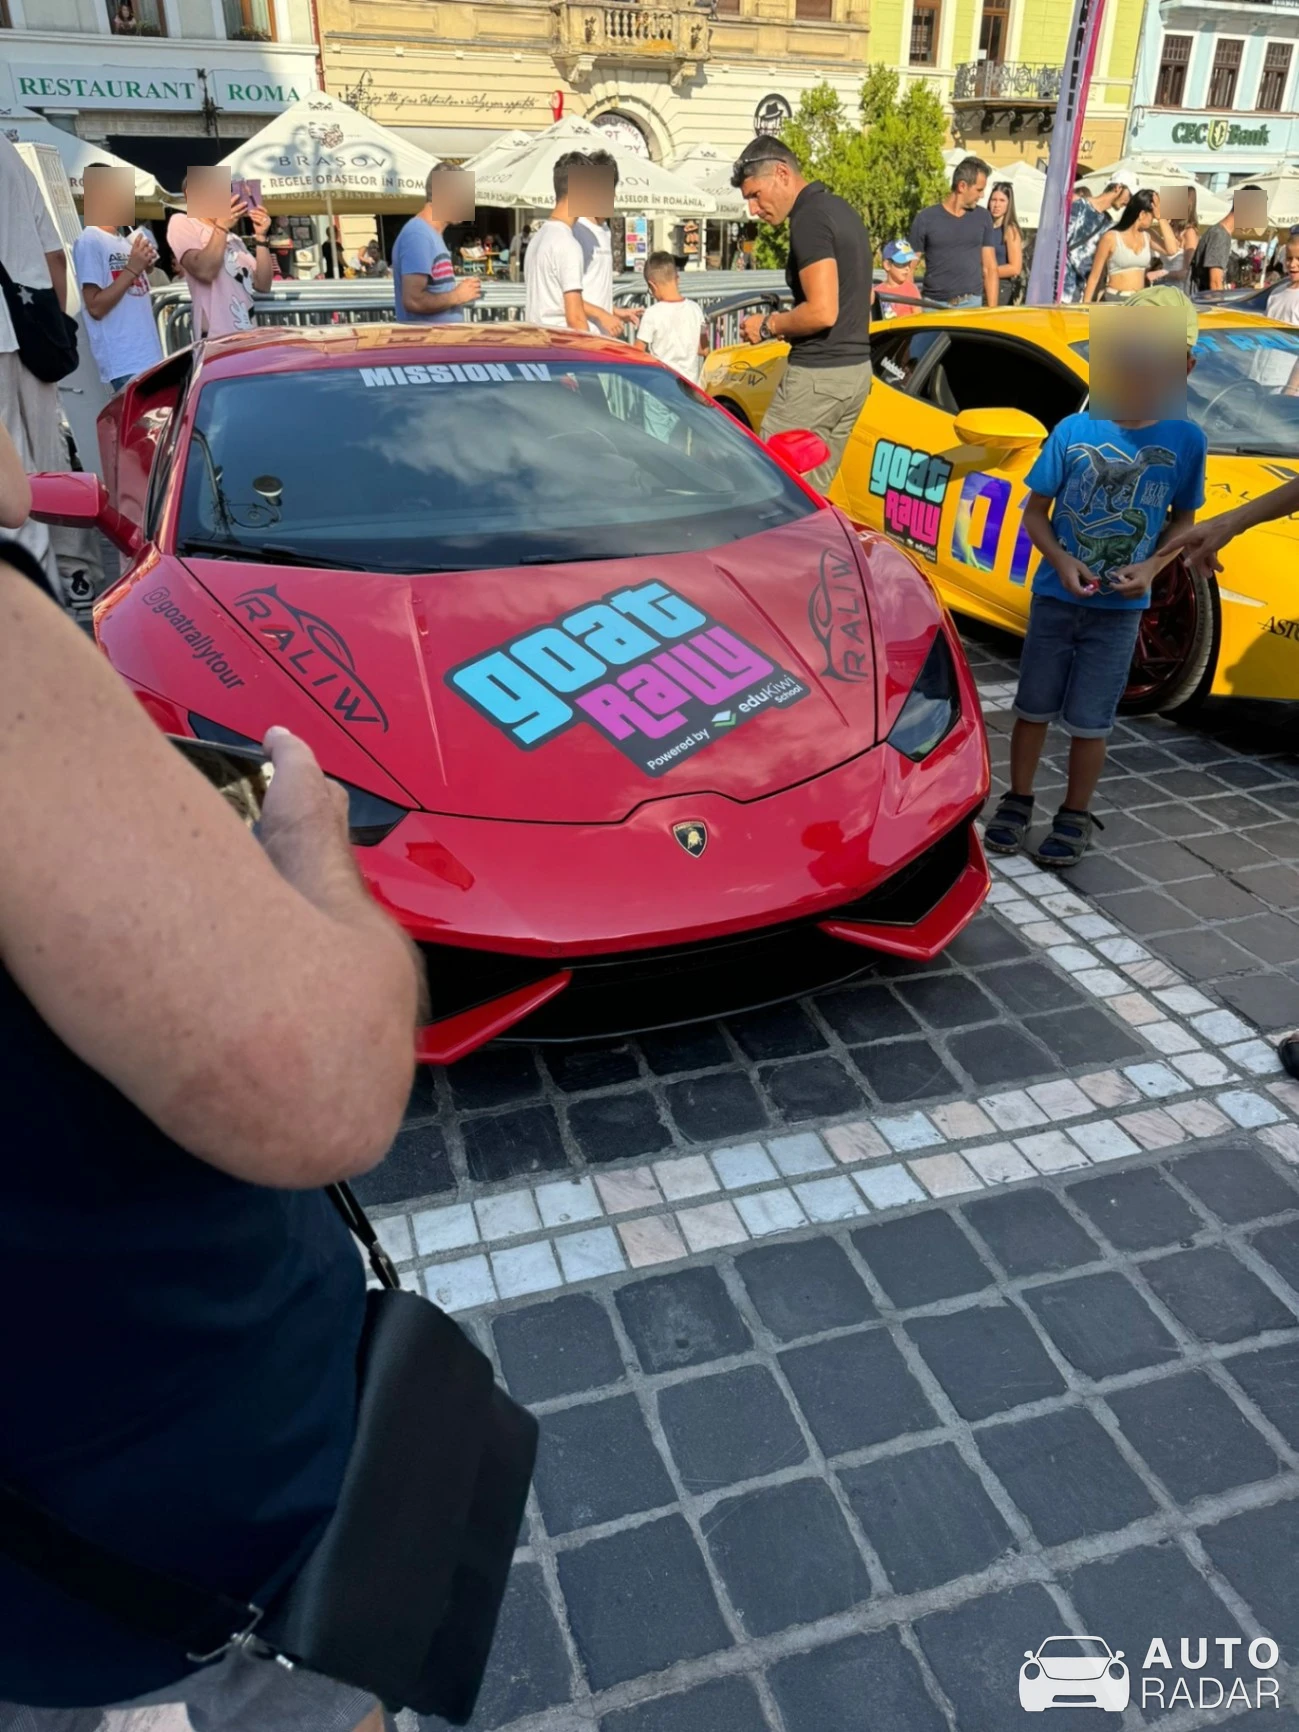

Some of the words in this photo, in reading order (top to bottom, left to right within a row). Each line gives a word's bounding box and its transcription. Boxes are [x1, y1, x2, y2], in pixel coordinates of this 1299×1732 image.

[18, 77, 195, 99] RESTAURANT
[228, 83, 301, 101] ROMA
[1172, 122, 1208, 144] CEC
[1226, 124, 1270, 146] Bank
[278, 155, 387, 168] BRAȘOV
[270, 175, 312, 188] REGELE
[315, 174, 377, 187] ORAȘELOR
[359, 364, 515, 387] MISSION
[516, 363, 552, 382] IV
[828, 553, 868, 677] RALIW
[234, 597, 381, 722] RALIW
[774, 685, 804, 703] School
[646, 736, 696, 770] Powered
[692, 728, 711, 742] by
